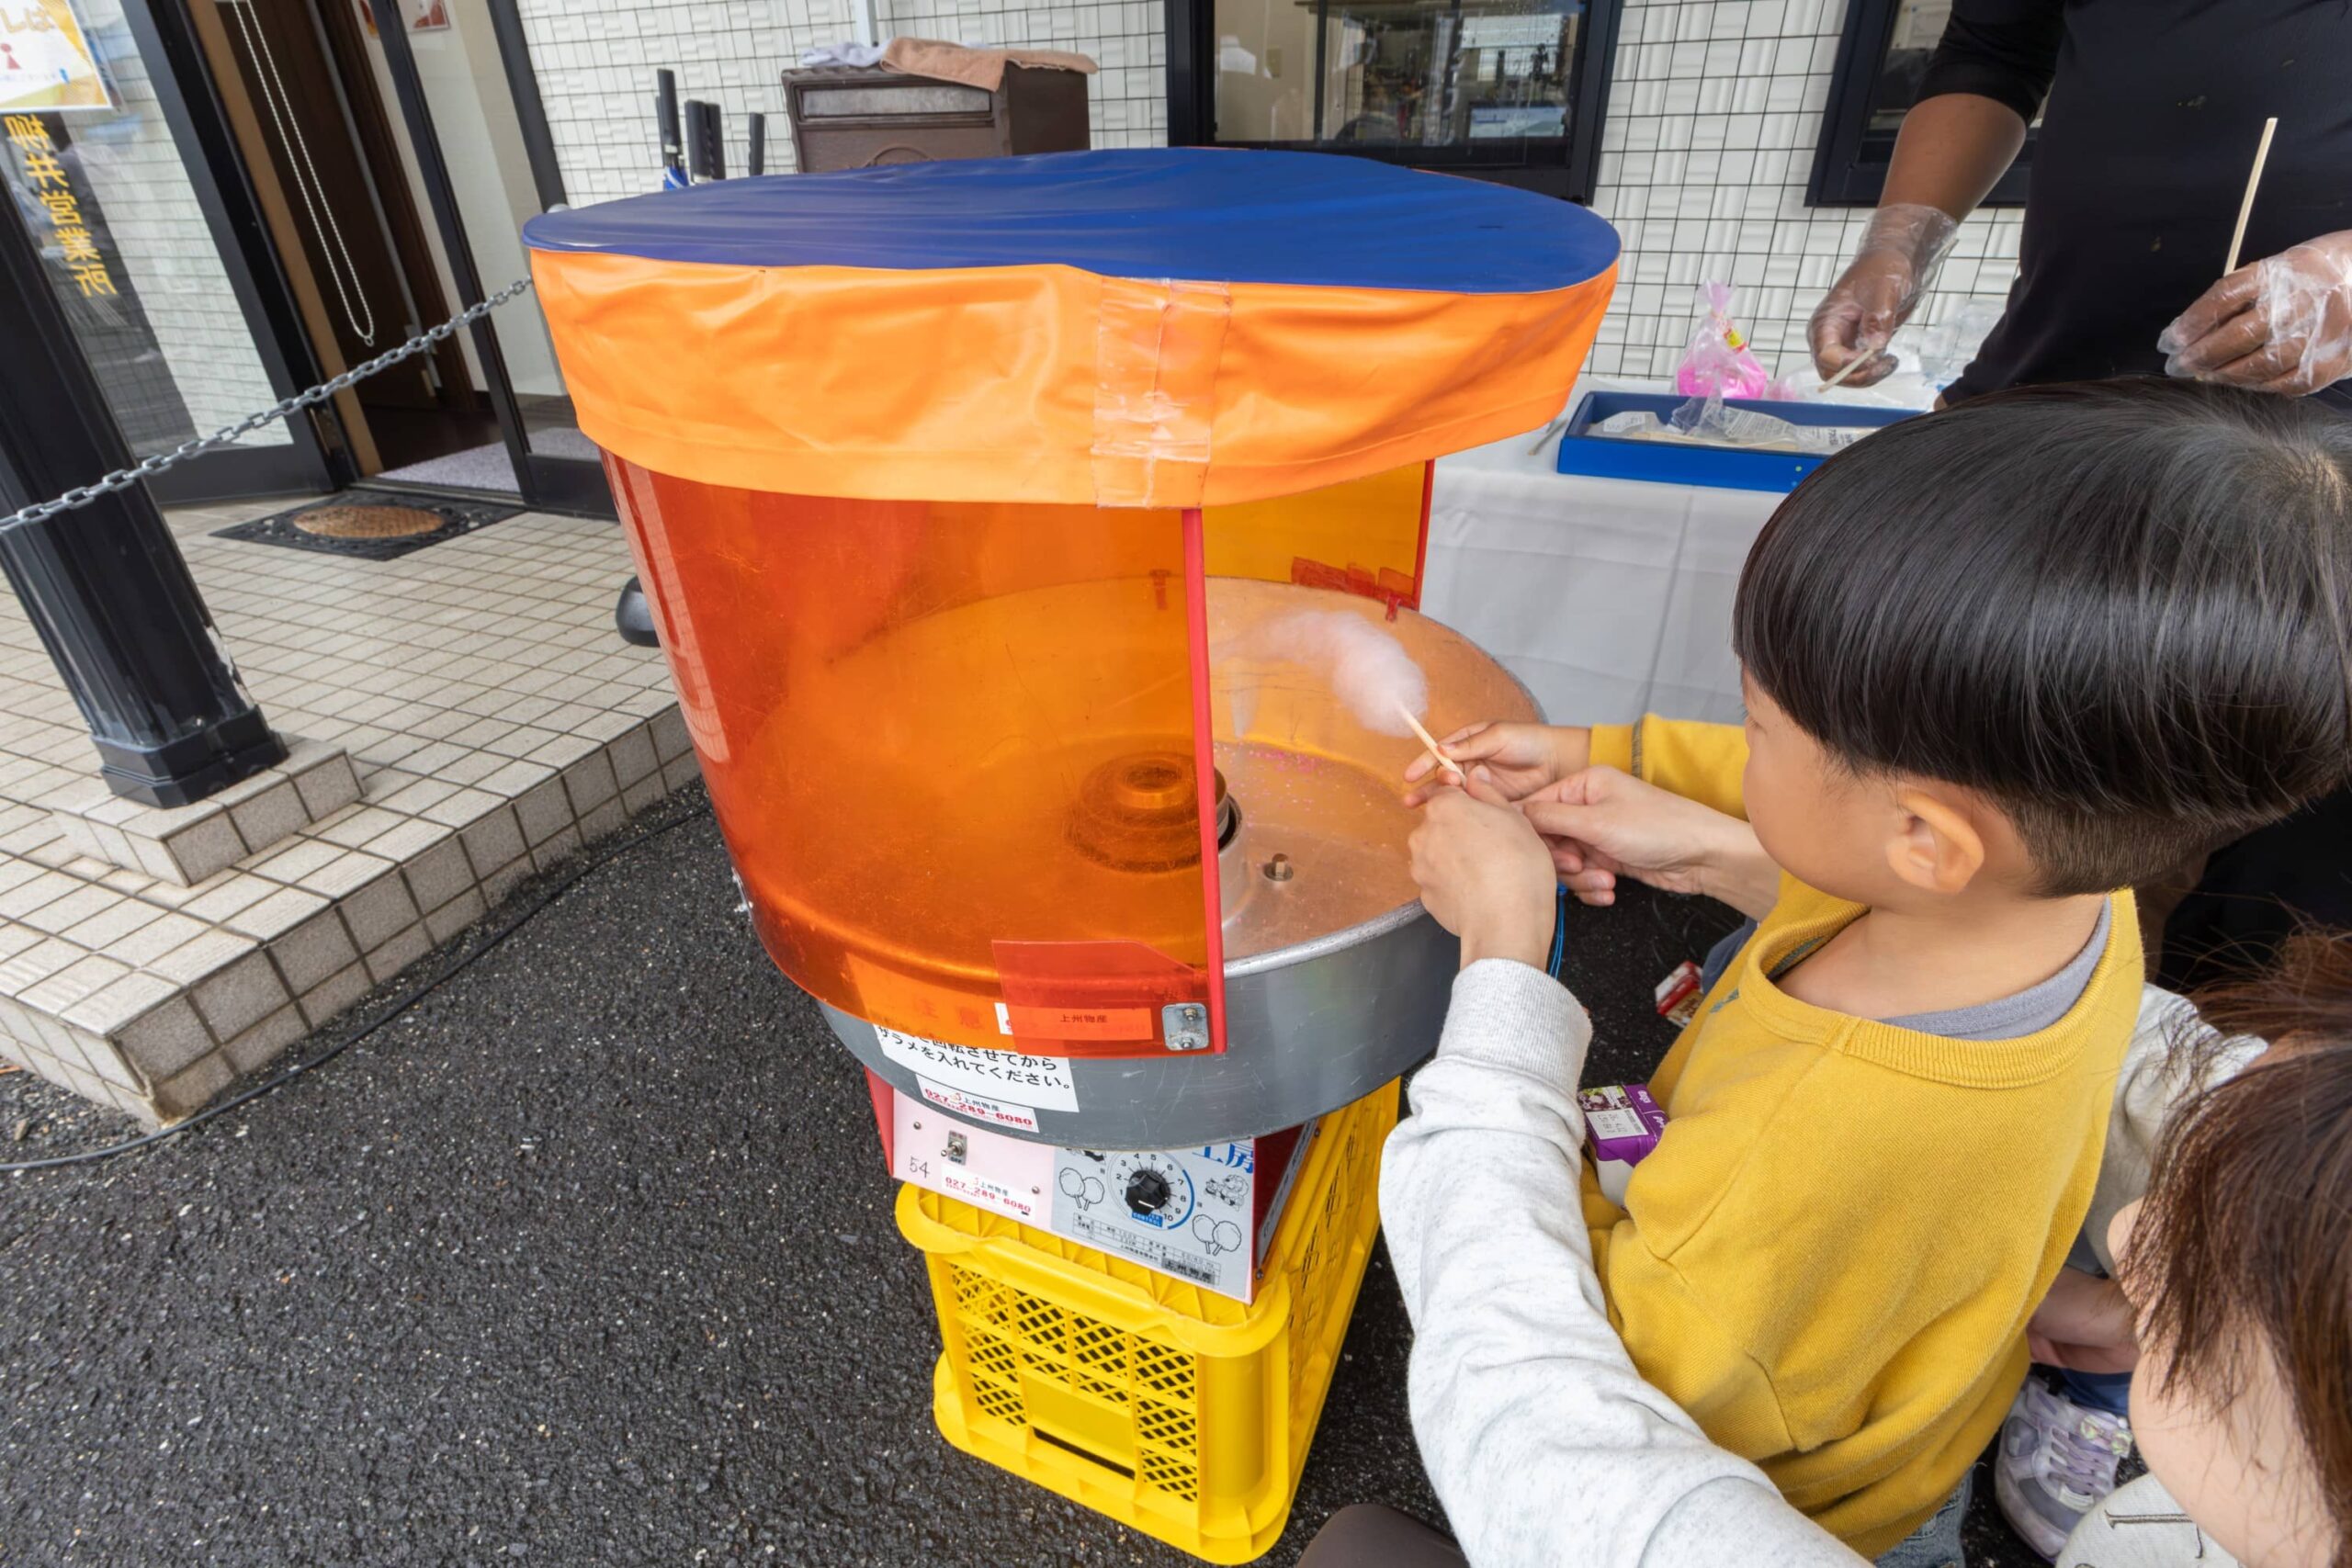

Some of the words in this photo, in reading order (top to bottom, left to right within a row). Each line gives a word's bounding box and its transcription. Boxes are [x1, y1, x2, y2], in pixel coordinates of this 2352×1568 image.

[1060, 1014, 1108, 1023] 上州物産
[965, 1098, 1000, 1111] 上州物産
[910, 1156, 930, 1178] 54
[1164, 1213, 1174, 1222] 10
